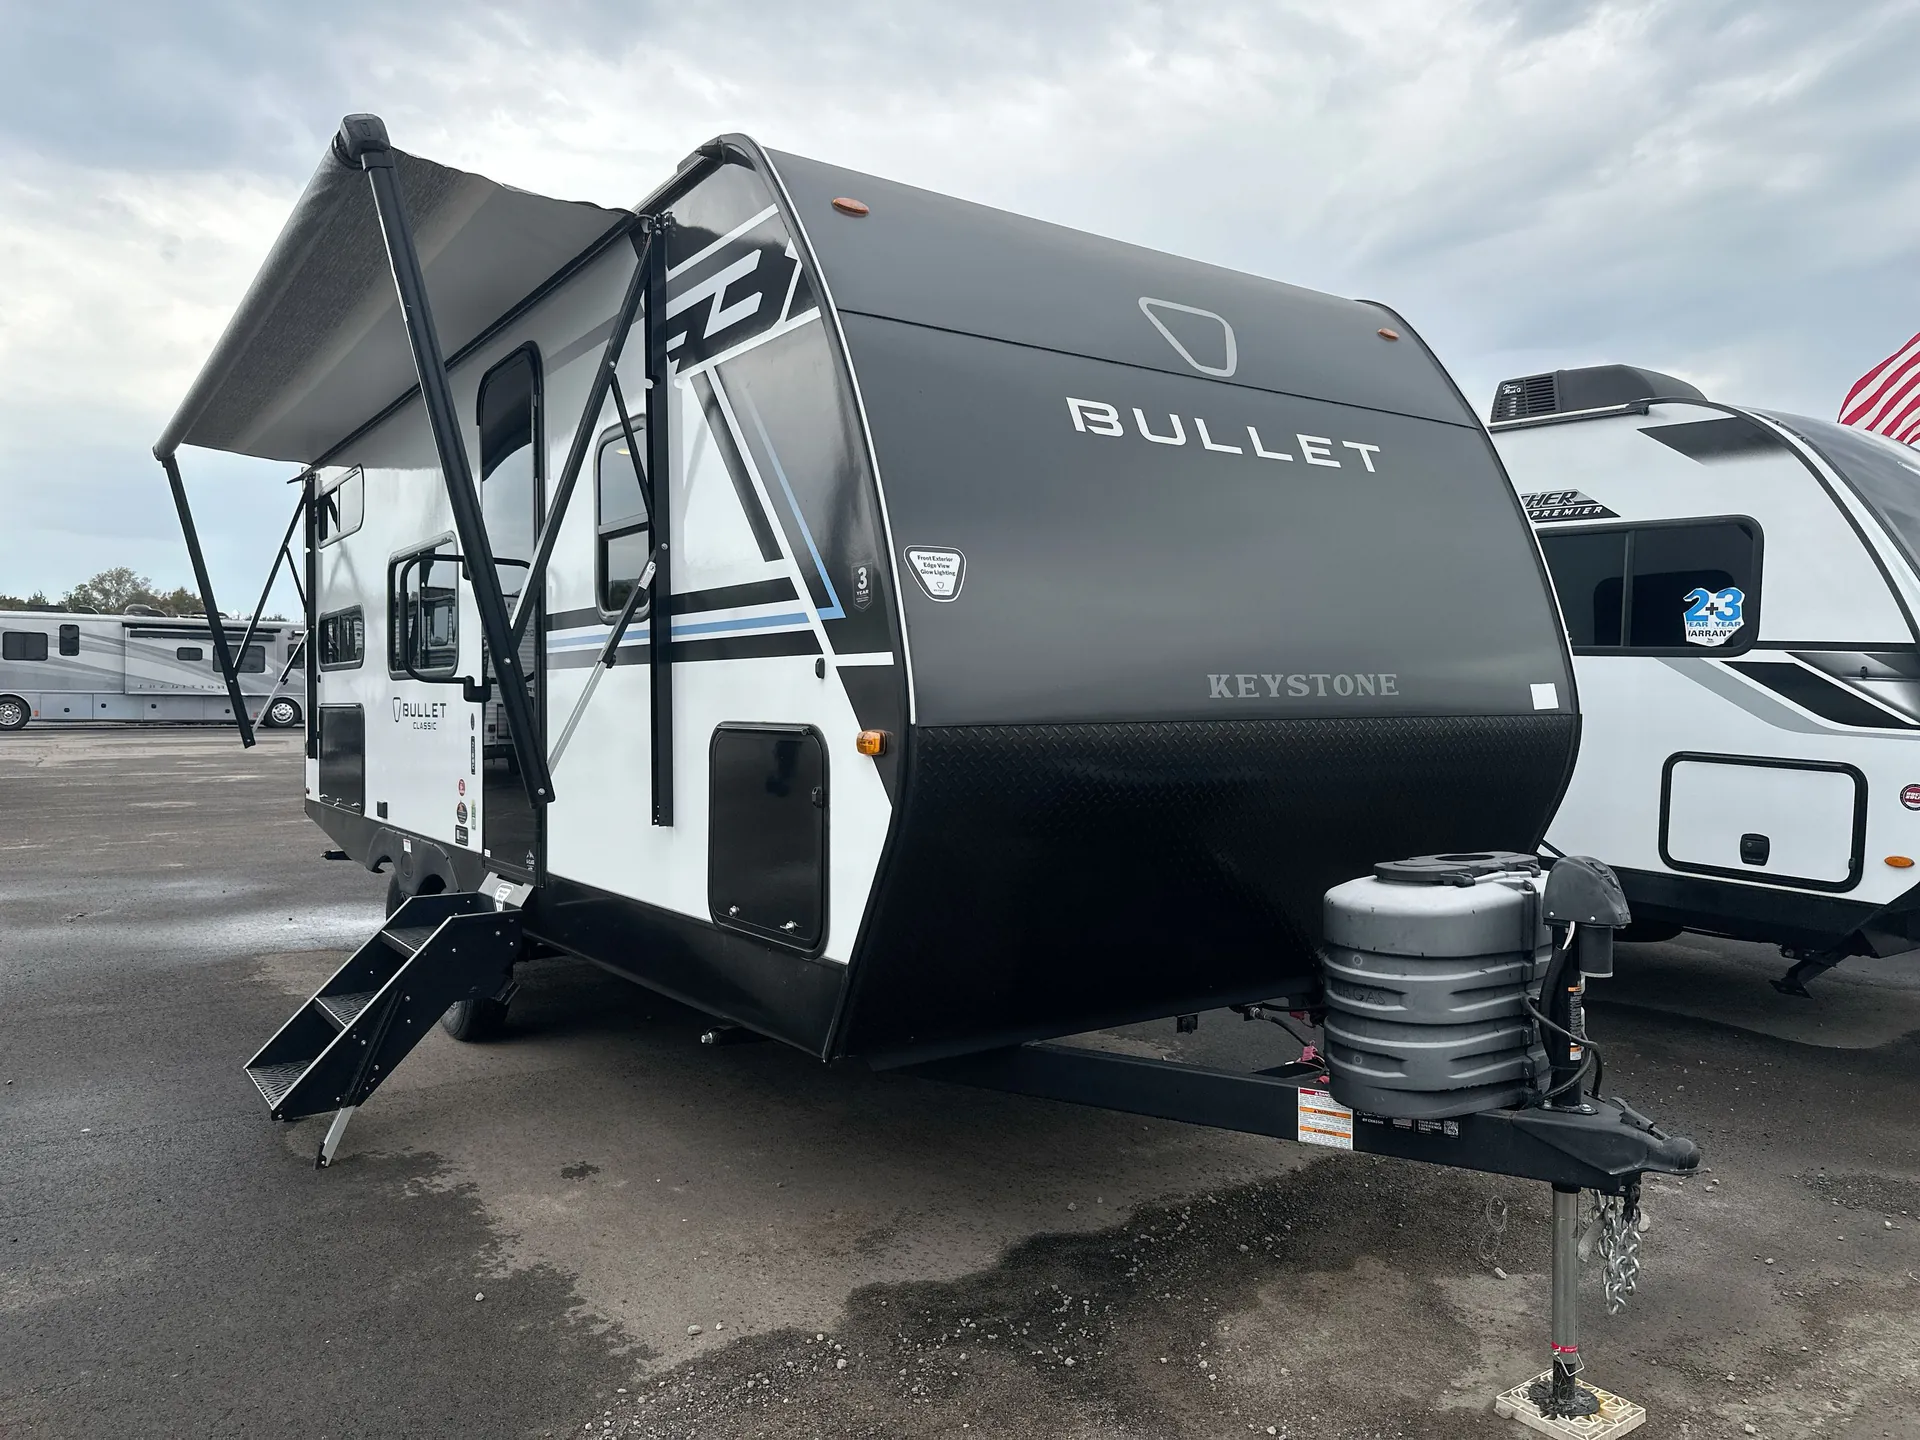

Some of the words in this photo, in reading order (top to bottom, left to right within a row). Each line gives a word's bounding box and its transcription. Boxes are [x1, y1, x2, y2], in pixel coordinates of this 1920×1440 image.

[1065, 396, 1381, 473] BULLET
[1530, 506, 1603, 518] PREMIER
[857, 566, 868, 590] 3
[934, 569, 956, 577] Lighting
[1207, 673, 1399, 699] KEYSTONE
[402, 702, 447, 718] BULLET
[413, 721, 437, 730] CLASSIC
